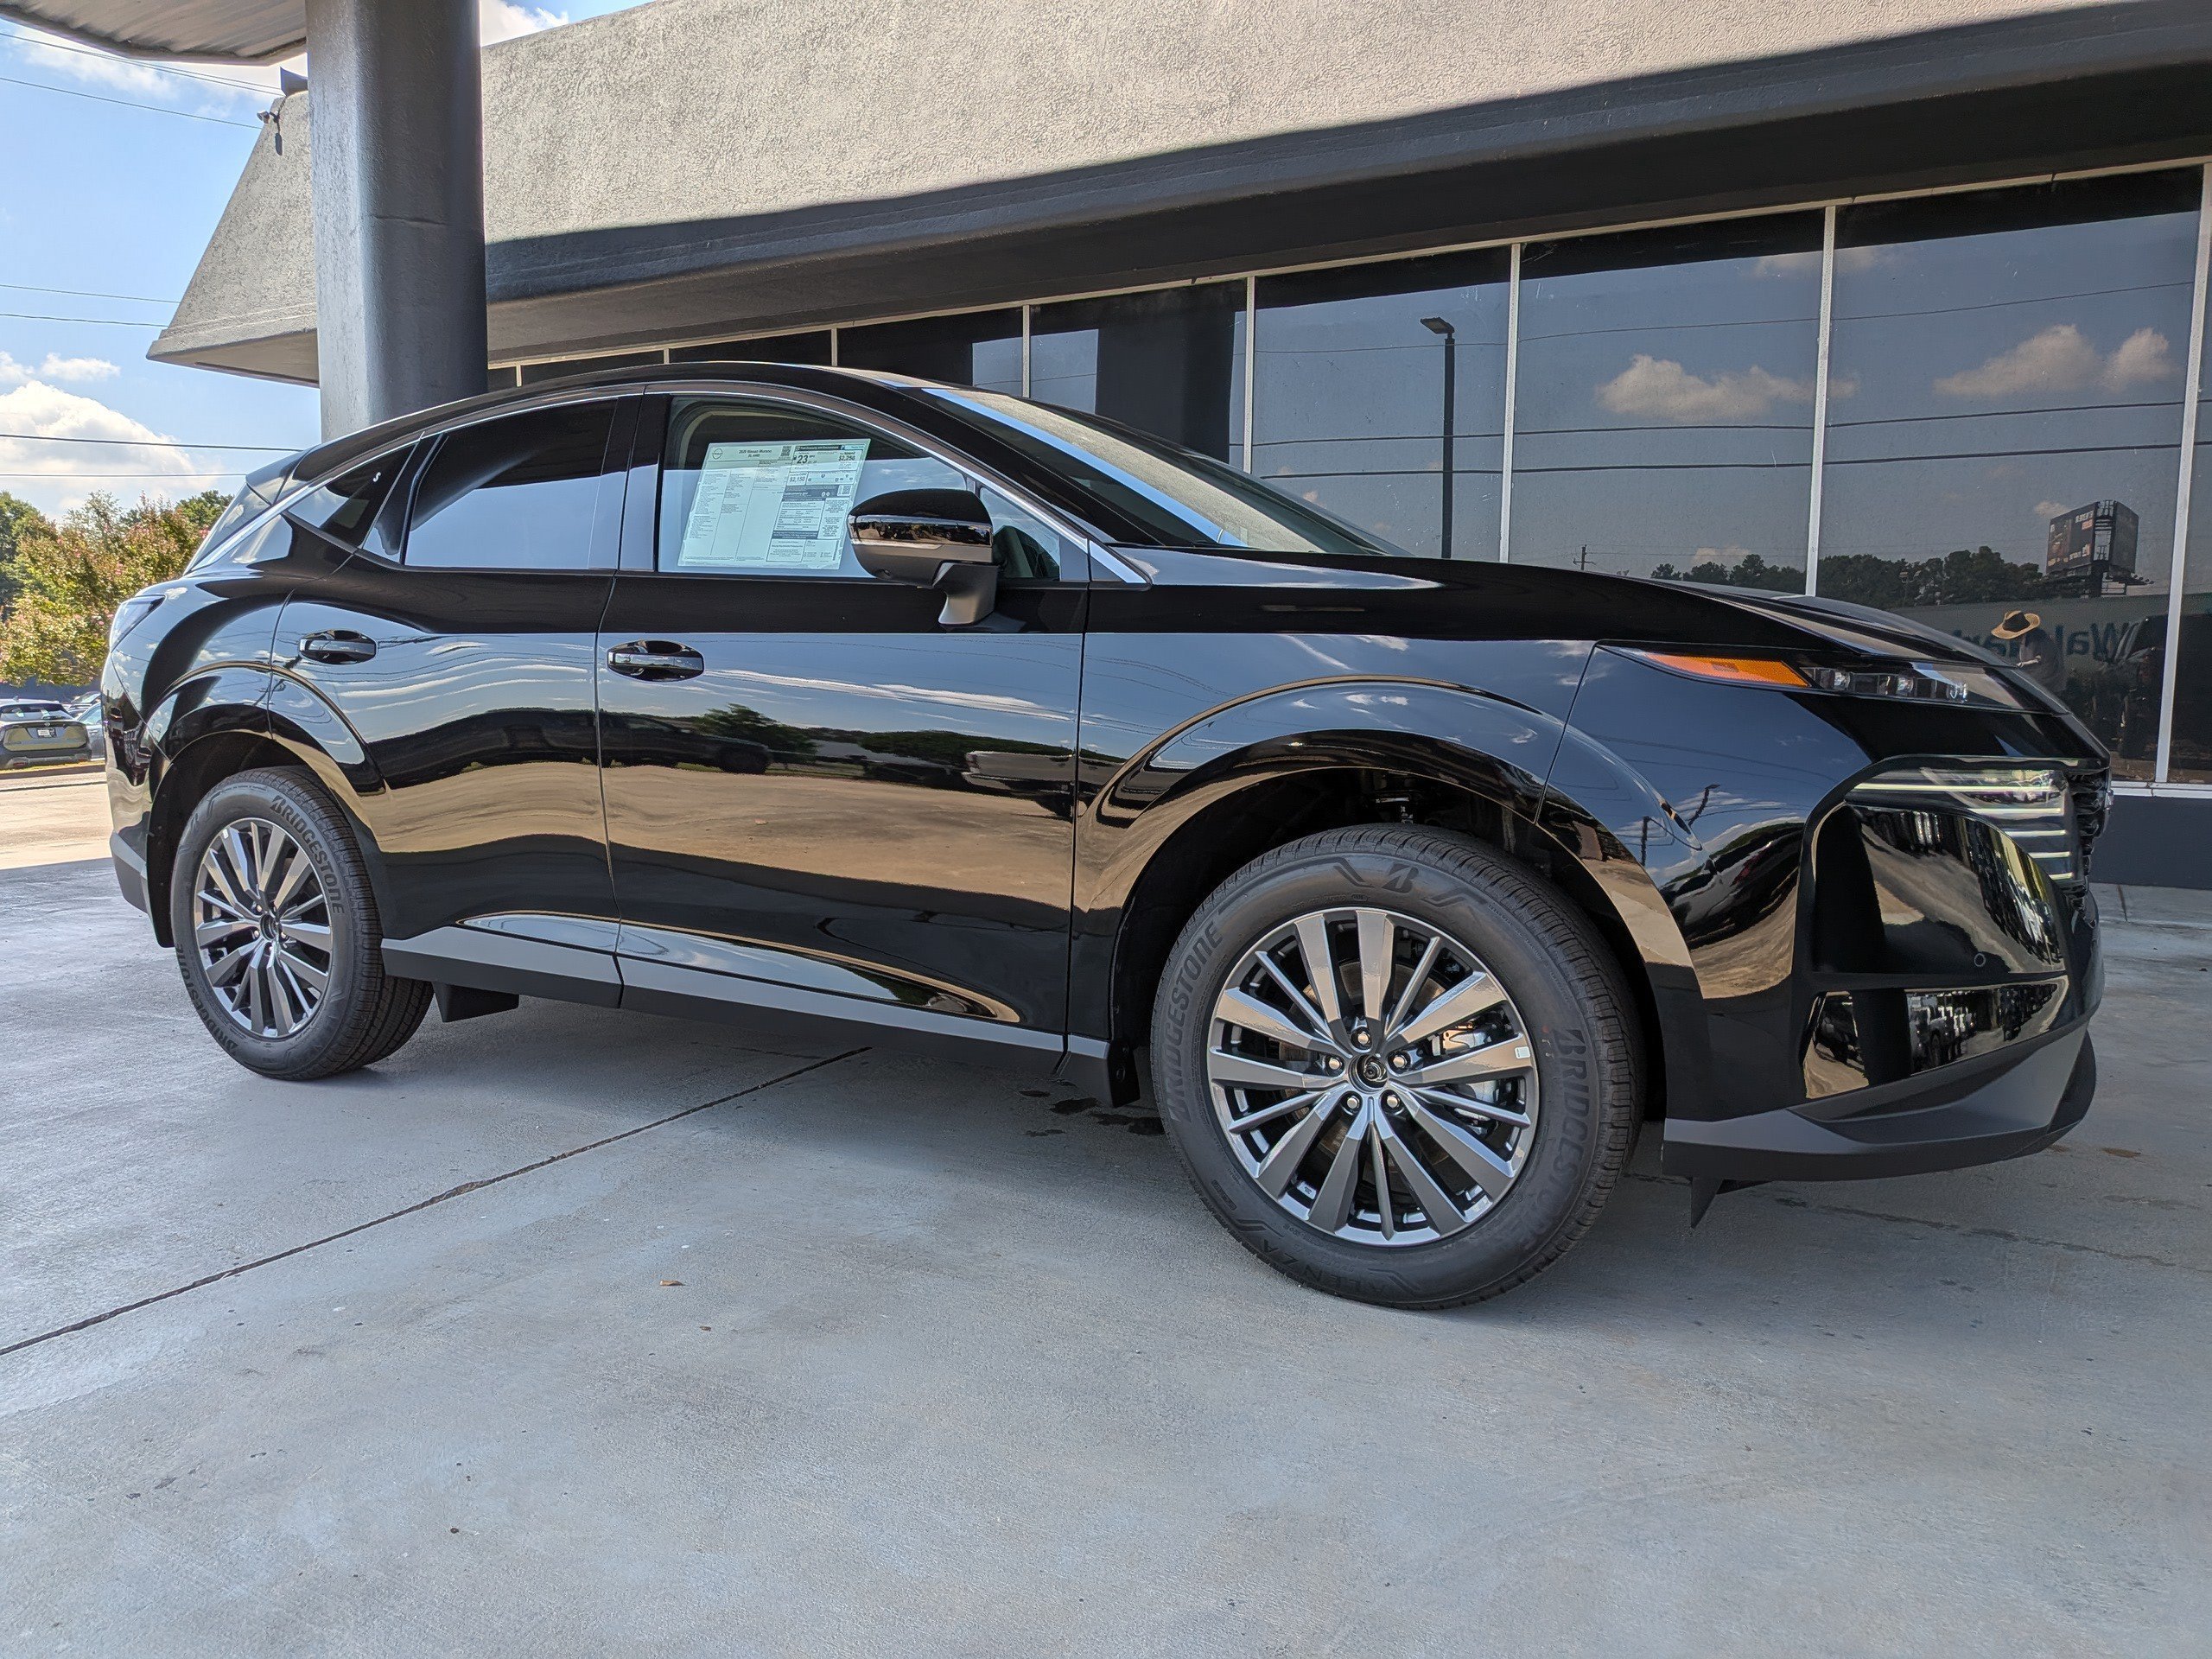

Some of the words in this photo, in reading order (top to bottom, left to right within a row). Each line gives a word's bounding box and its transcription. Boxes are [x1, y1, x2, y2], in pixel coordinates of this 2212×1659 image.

[797, 454, 808, 464] 23
[270, 795, 345, 914] BRIDGESTONE
[1164, 919, 1224, 1123] BRIDGESTONE
[1263, 1240, 1385, 1294] ALENZA
